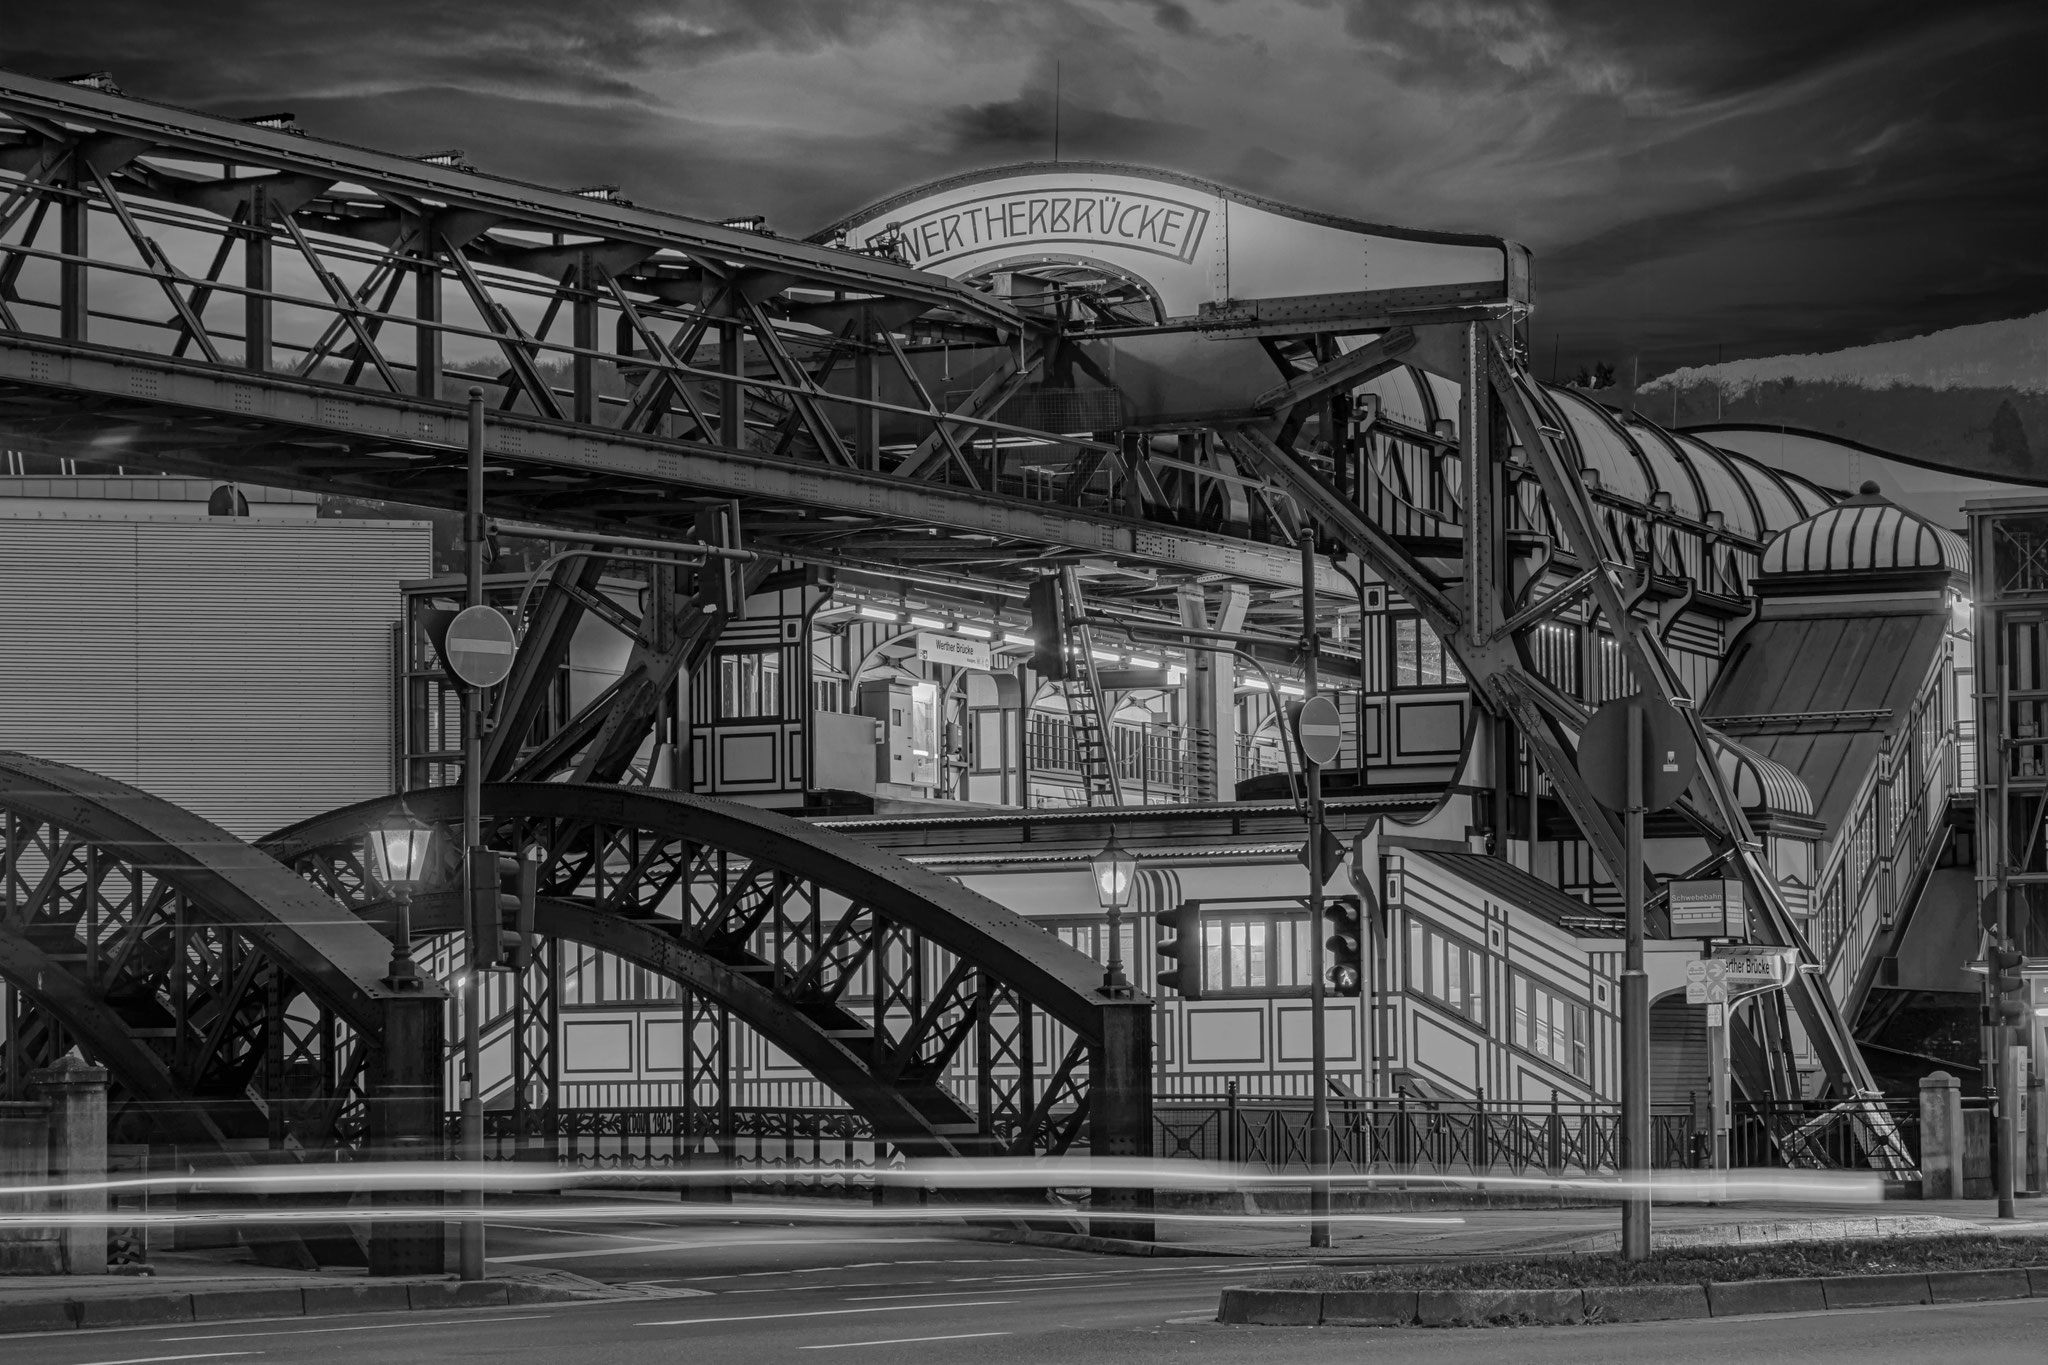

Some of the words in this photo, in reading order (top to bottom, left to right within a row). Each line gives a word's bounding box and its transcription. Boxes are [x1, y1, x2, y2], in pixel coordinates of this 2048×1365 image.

[936, 639, 955, 653] Werther
[956, 642, 974, 656] Brücke
[1671, 893, 1722, 902] Schwebebahn
[1746, 957, 1770, 975] Brücke
